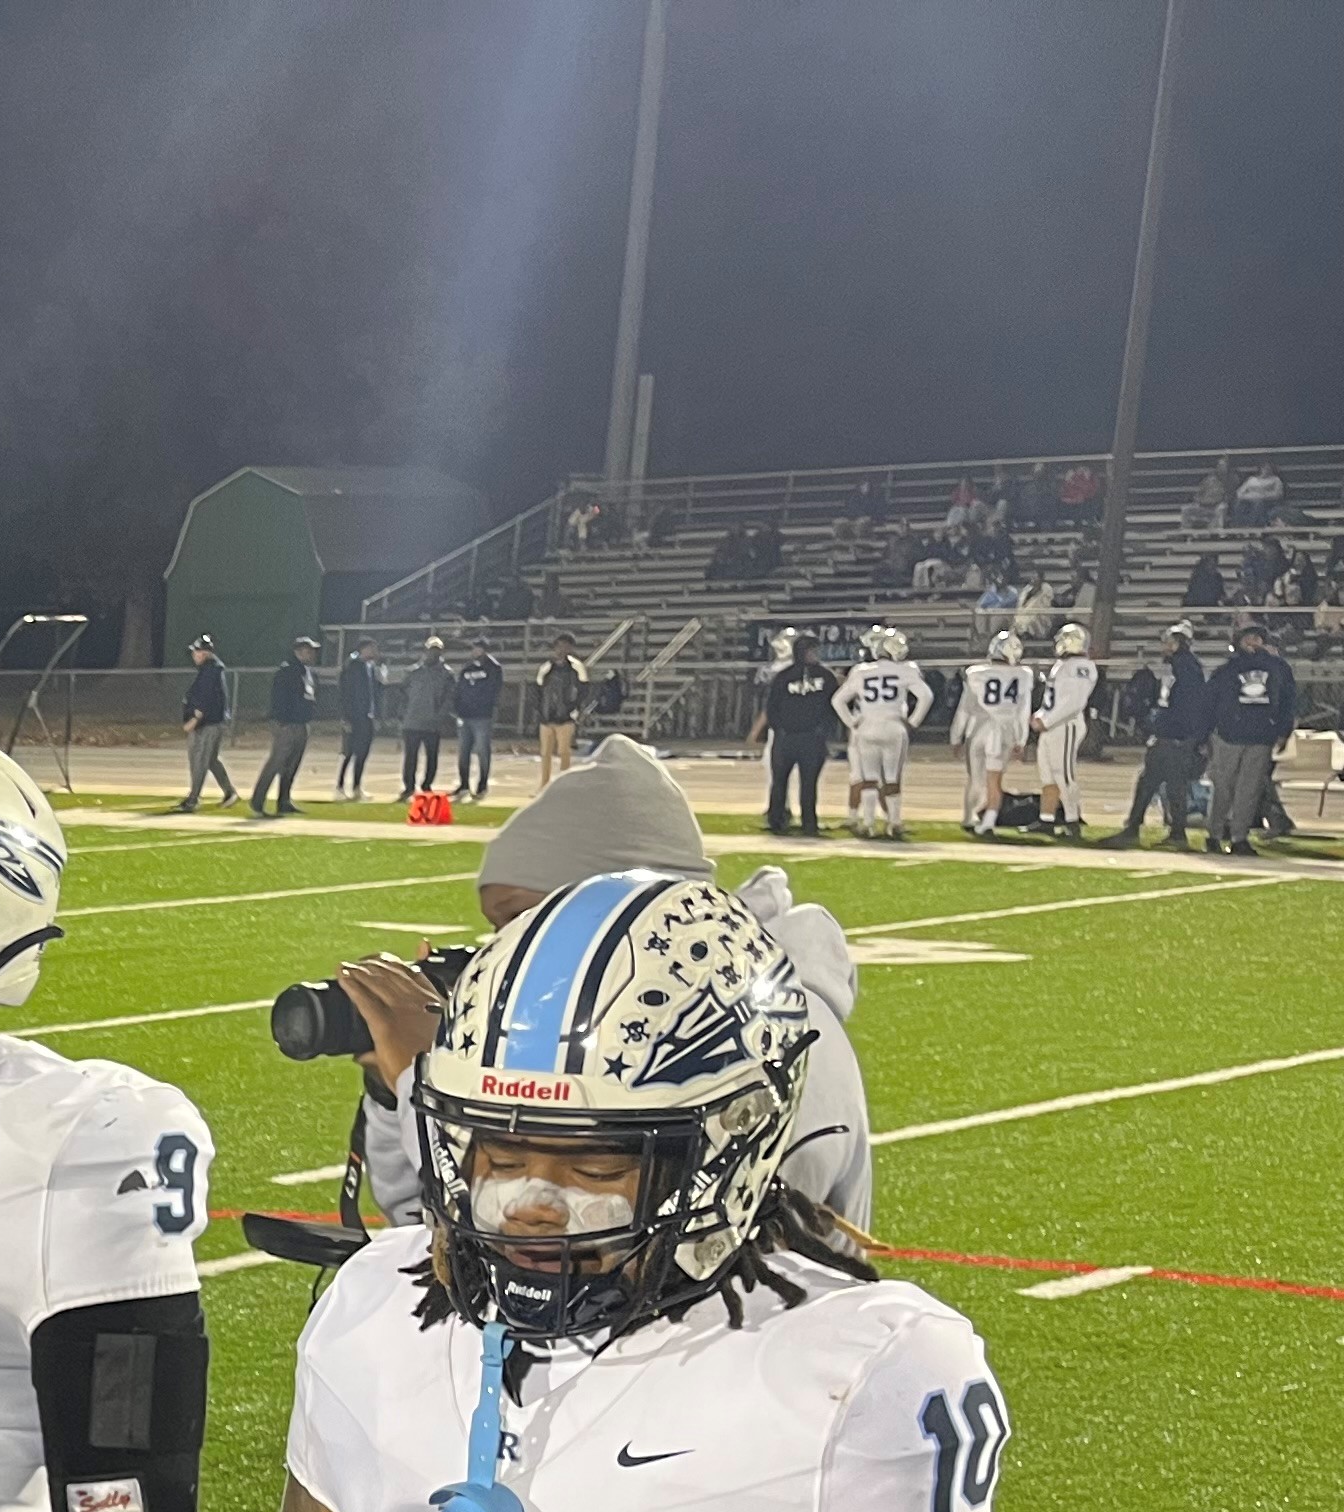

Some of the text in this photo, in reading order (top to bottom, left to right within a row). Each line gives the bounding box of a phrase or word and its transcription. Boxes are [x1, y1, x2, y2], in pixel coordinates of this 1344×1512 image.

[863, 675, 900, 702] 55
[983, 678, 1020, 705] 84
[408, 794, 441, 823] 30
[481, 1074, 570, 1101] Riddell
[153, 1131, 199, 1237] 9
[496, 1430, 520, 1462] R
